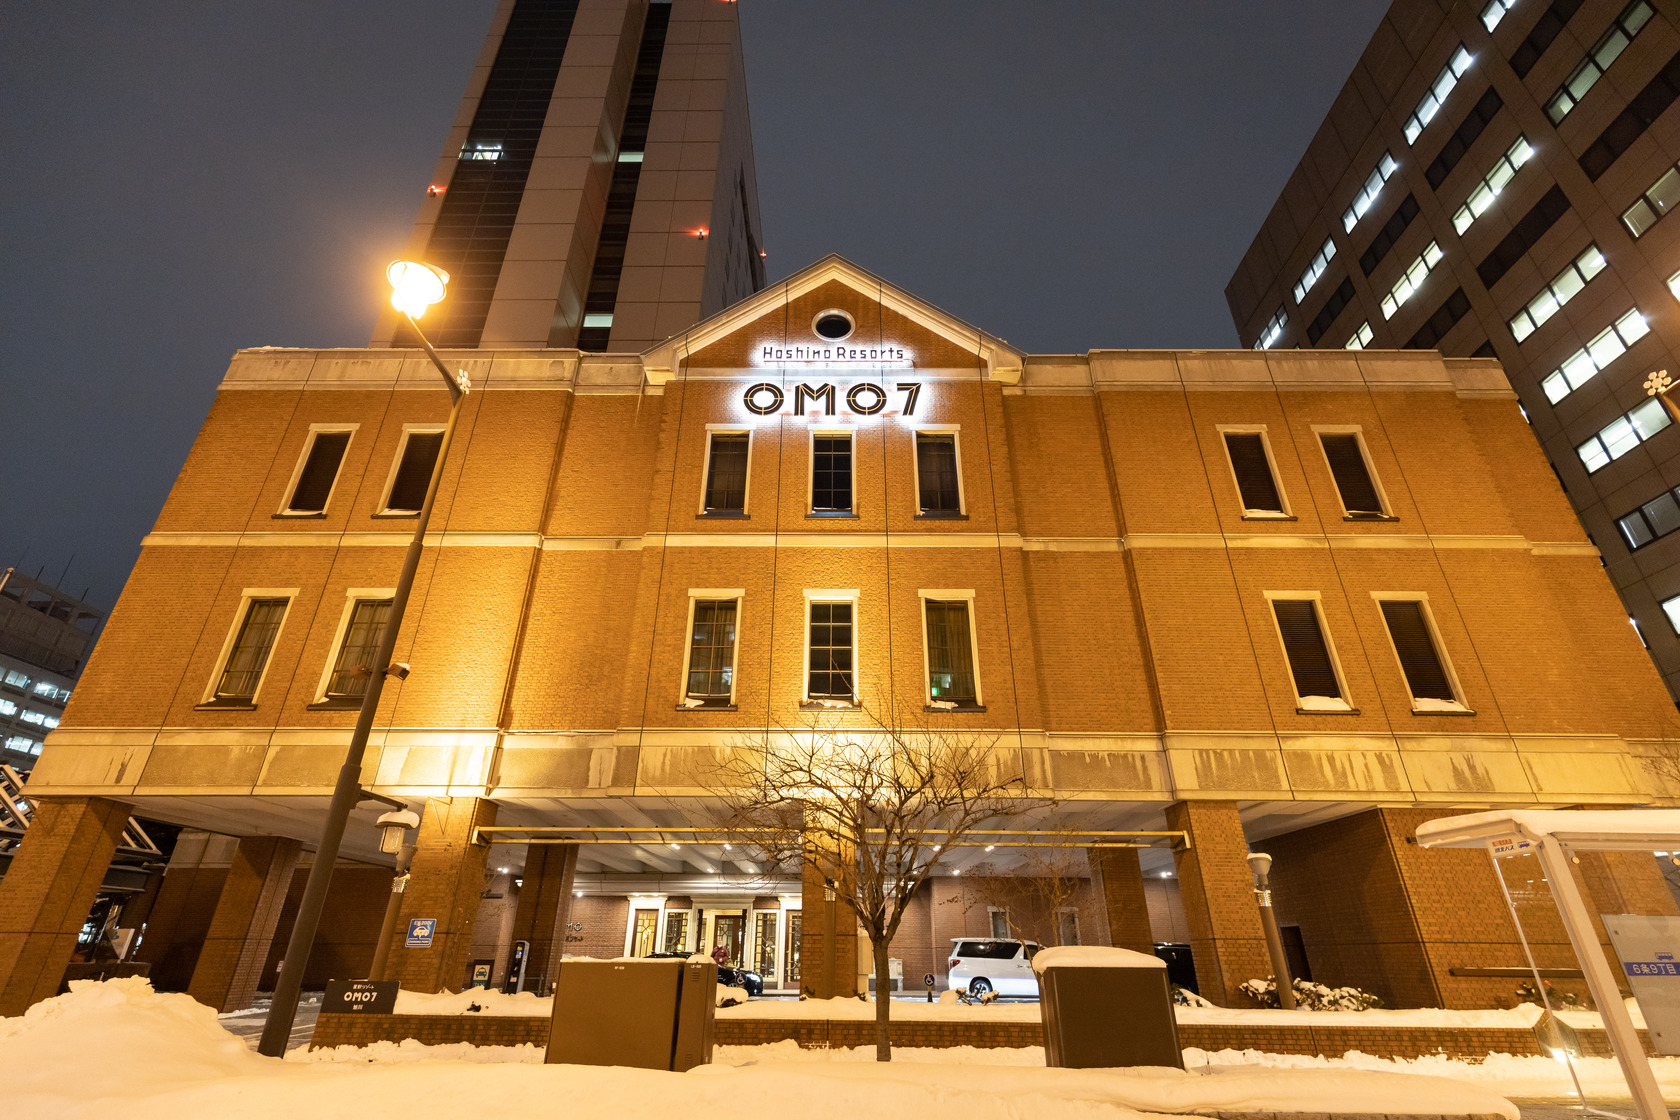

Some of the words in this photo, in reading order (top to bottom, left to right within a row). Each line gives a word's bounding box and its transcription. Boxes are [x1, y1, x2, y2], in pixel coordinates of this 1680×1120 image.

[763, 346, 831, 360] Hoshino
[836, 346, 904, 360] Resorts
[743, 382, 922, 416] OMO7
[1632, 963, 1677, 975] 6条9丁目
[343, 991, 378, 1002] OMO7
